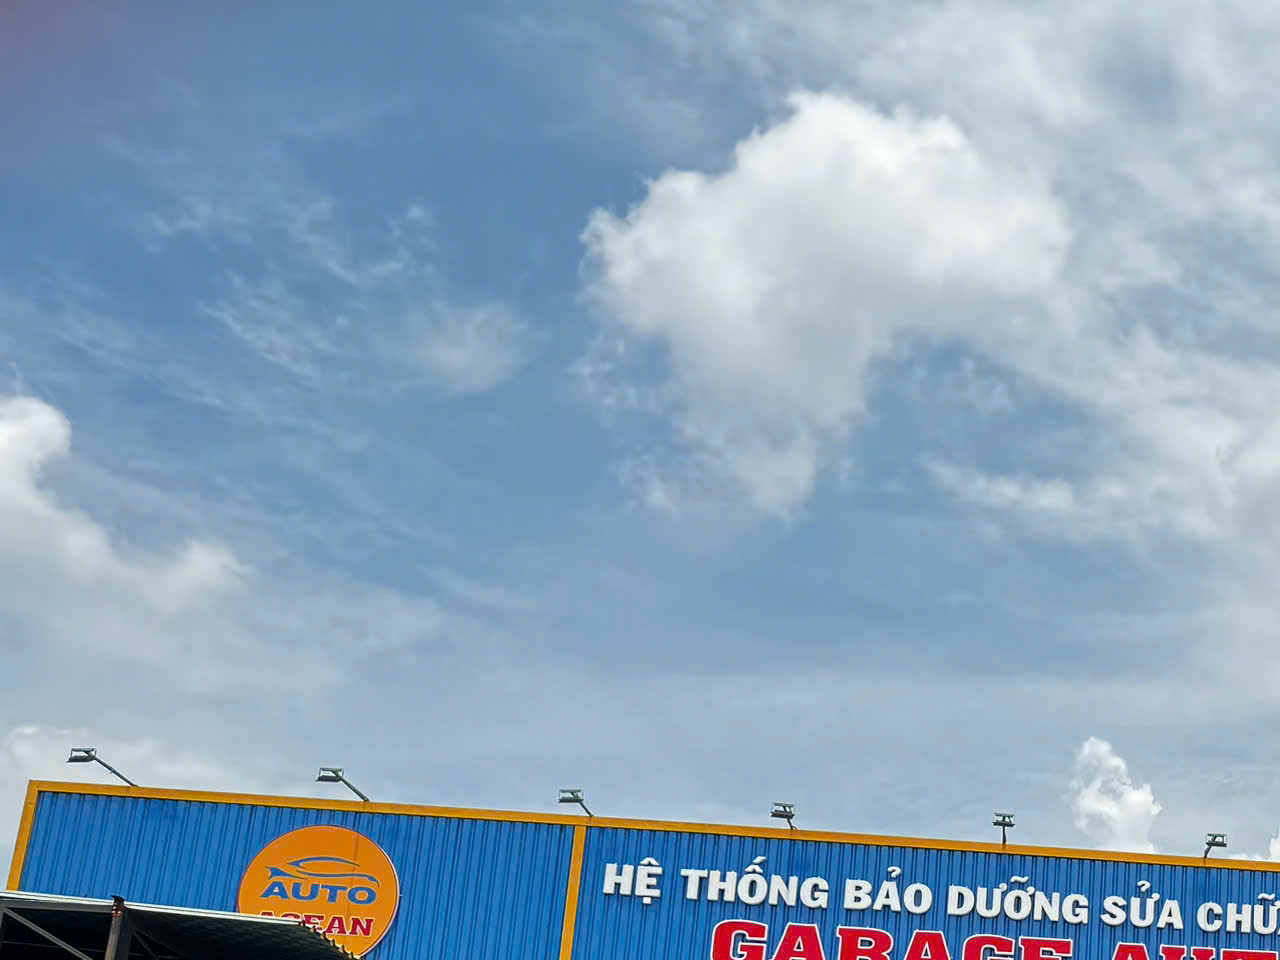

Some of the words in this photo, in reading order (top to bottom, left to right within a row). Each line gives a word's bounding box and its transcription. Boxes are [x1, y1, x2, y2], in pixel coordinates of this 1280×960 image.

[260, 881, 377, 905] AUTO
[603, 857, 662, 904] HỆ
[681, 856, 829, 909] THỐNG
[844, 866, 933, 914] BẢO
[948, 875, 1088, 925] DƯỠNG
[1101, 881, 1183, 930] SỬA
[262, 912, 375, 937] EAN
